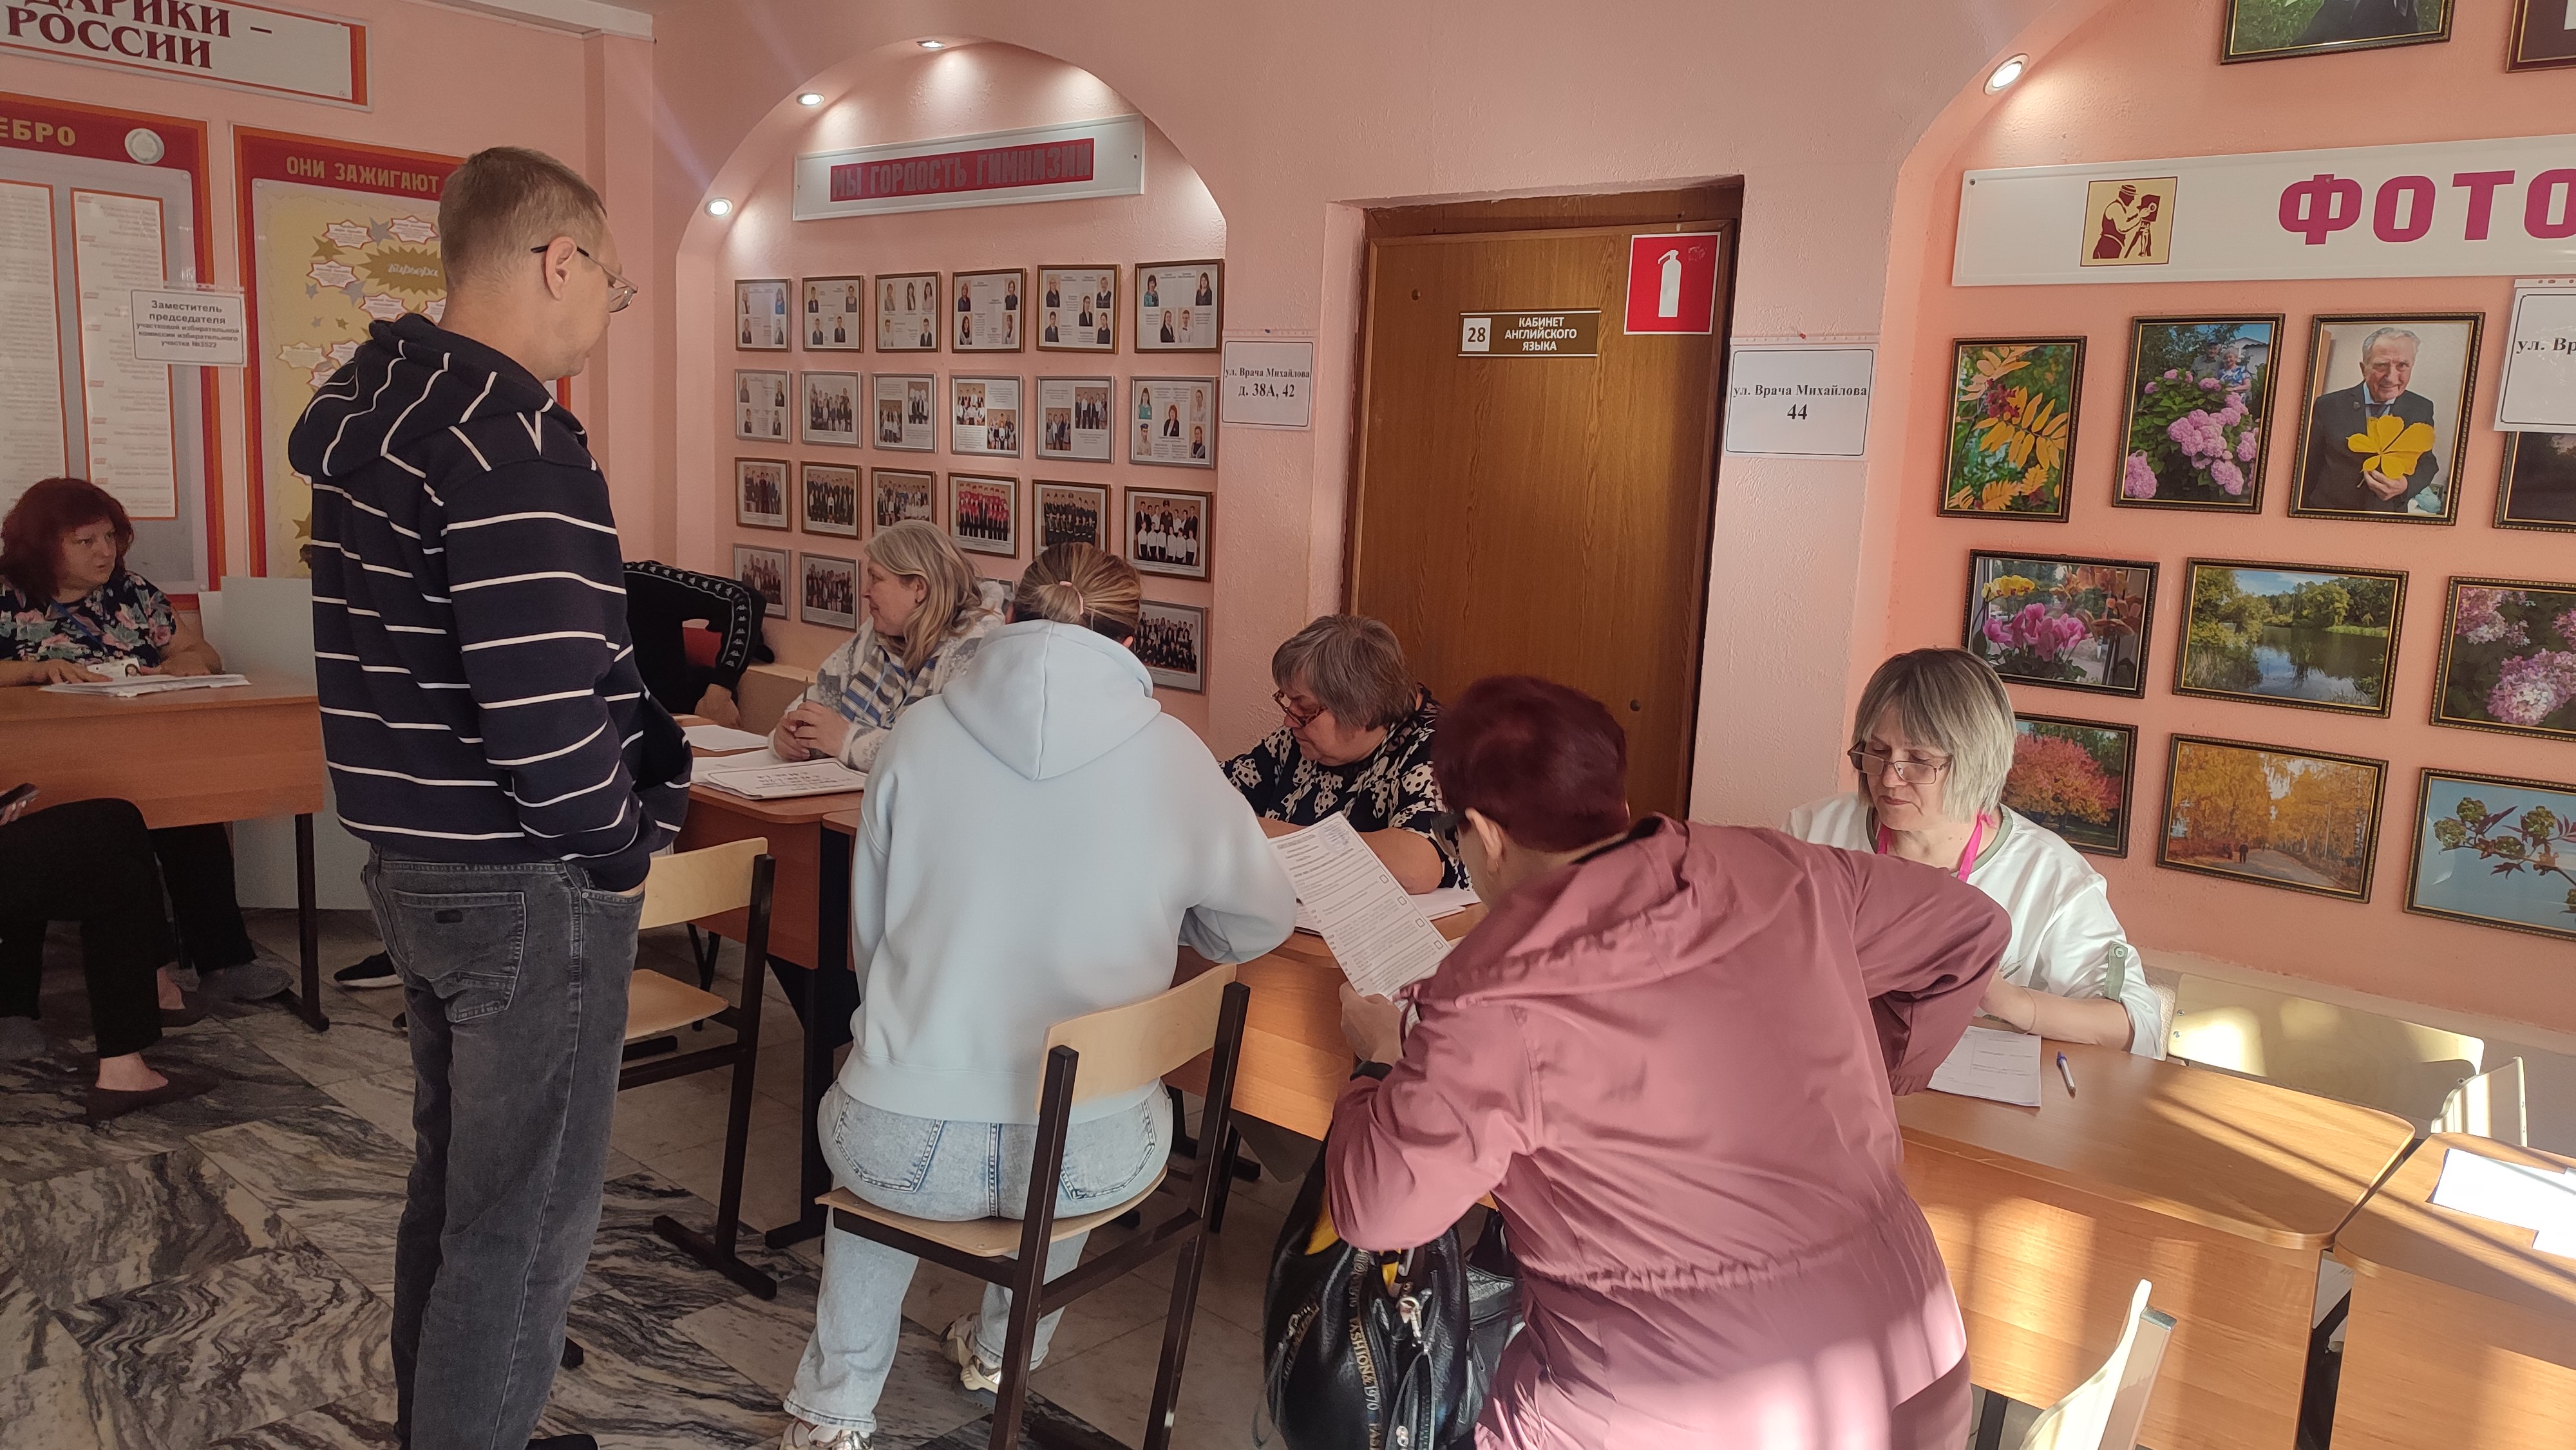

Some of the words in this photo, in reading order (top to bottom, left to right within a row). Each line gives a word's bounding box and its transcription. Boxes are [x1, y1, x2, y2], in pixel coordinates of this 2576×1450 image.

[24, 0, 232, 38] РИКИ
[6, 5, 213, 70] РОССИИ
[287, 156, 325, 179] ОНИ
[334, 162, 440, 194] ЗАЖИГАЮТ
[870, 156, 966, 194] ГОРДОСТЬ
[976, 143, 1092, 186] ГИМНАЗИИ
[2278, 168, 2576, 245] ФОТО
[151, 300, 222, 313] Заместитель
[149, 313, 226, 325] председателя
[1519, 317, 1565, 327] КАБИНЕТ
[1467, 326, 1486, 343] 28
[1504, 326, 1577, 339] АНГЛИЙСКОГО
[1522, 341, 1558, 352] ЯЗЫКА
[2515, 340, 2546, 355] ул.
[1225, 369, 1237, 379] ул.
[1240, 367, 1264, 379] Врача
[1265, 368, 1310, 378] Михайлова
[1238, 386, 1249, 397] д.
[1282, 384, 1295, 397] 42
[1732, 387, 1750, 398] ул.
[1755, 384, 1792, 398] Врача
[1795, 384, 1867, 397] Михайлова
[1786, 403, 1808, 420] 44
